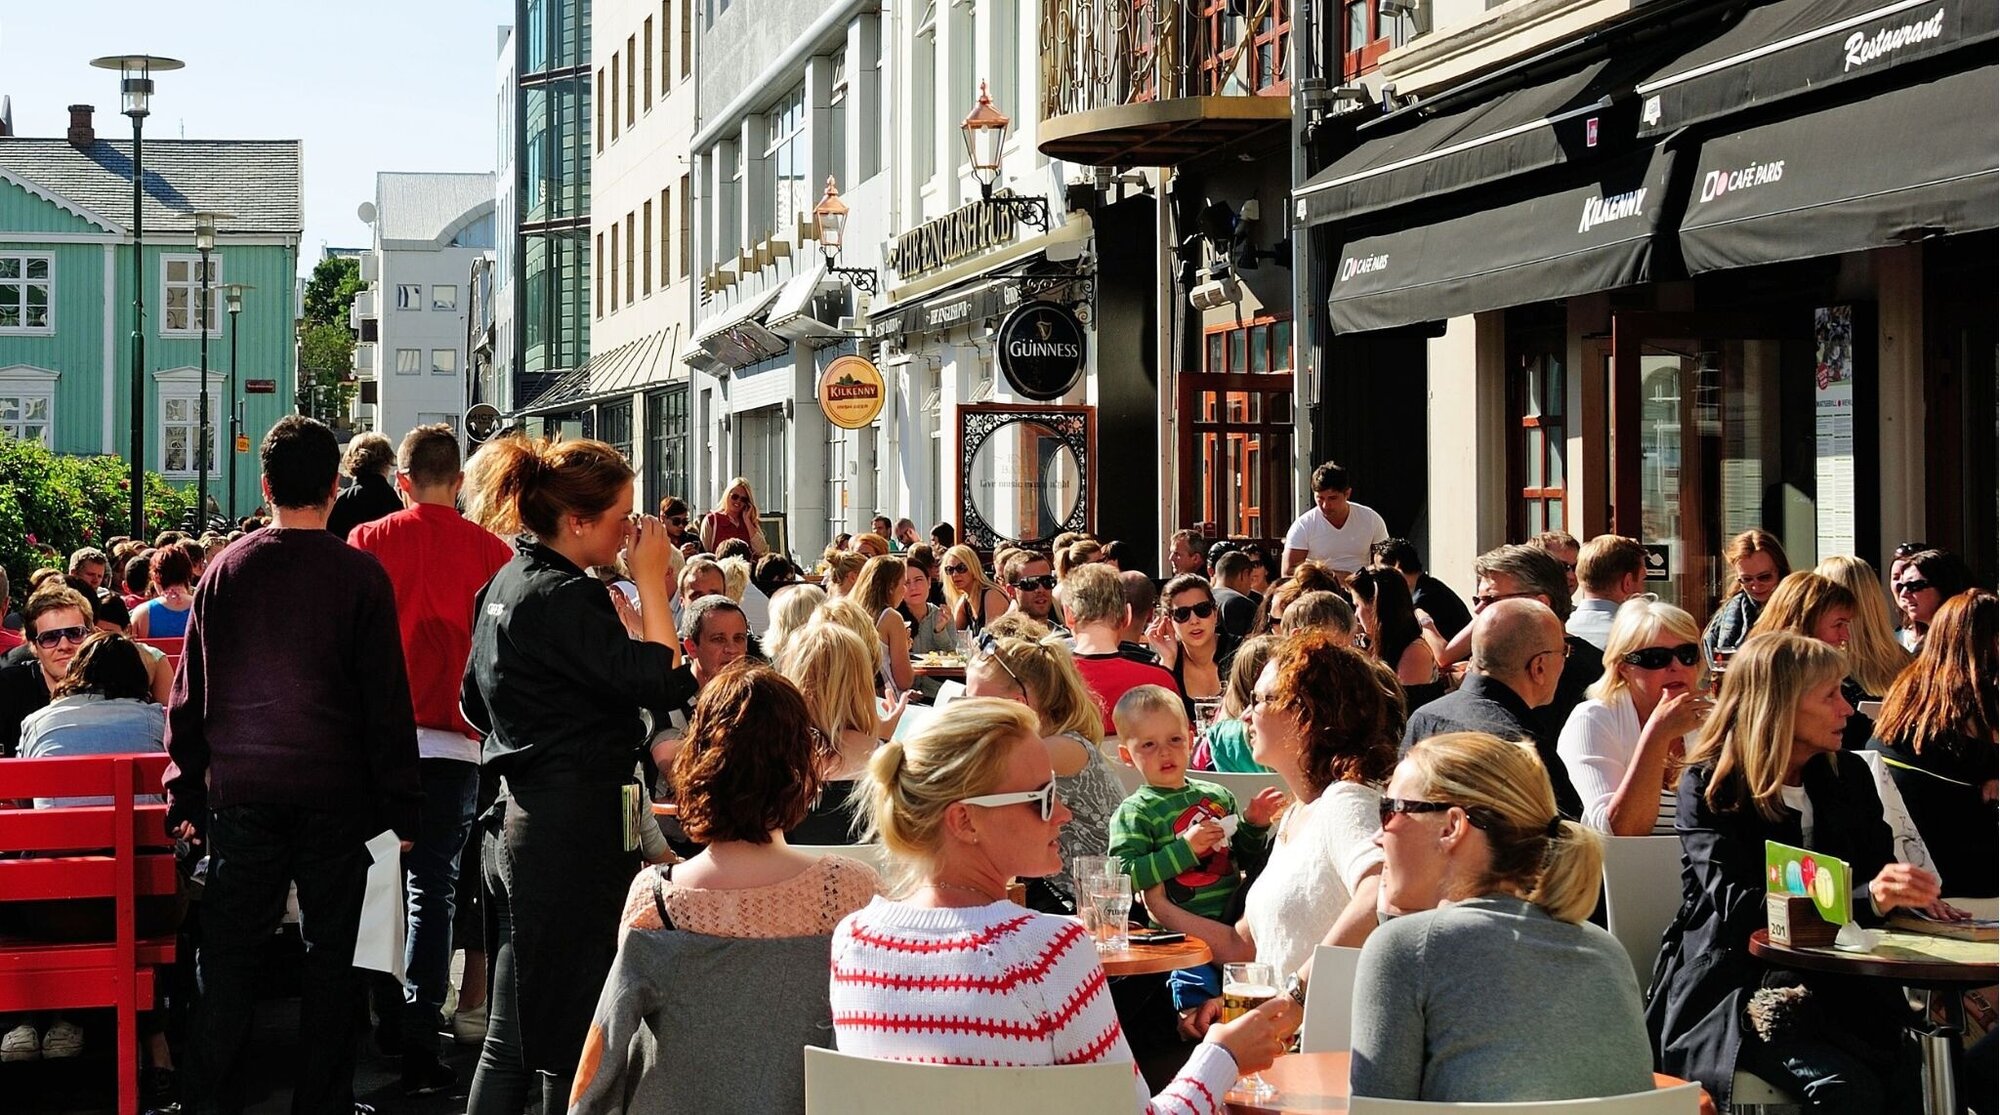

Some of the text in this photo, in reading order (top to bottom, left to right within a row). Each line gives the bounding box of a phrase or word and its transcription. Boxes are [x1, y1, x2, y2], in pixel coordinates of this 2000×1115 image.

[1844, 7, 1945, 72] Restaurant
[1728, 160, 1785, 191] CAFÉ PARIS
[1578, 187, 1648, 234] KILKENNY
[898, 189, 1014, 280] THE ENGLISH PUB
[1371, 254, 1389, 271] PARIS
[831, 386, 876, 398] KILKENNY
[1771, 923, 1786, 937] 201
